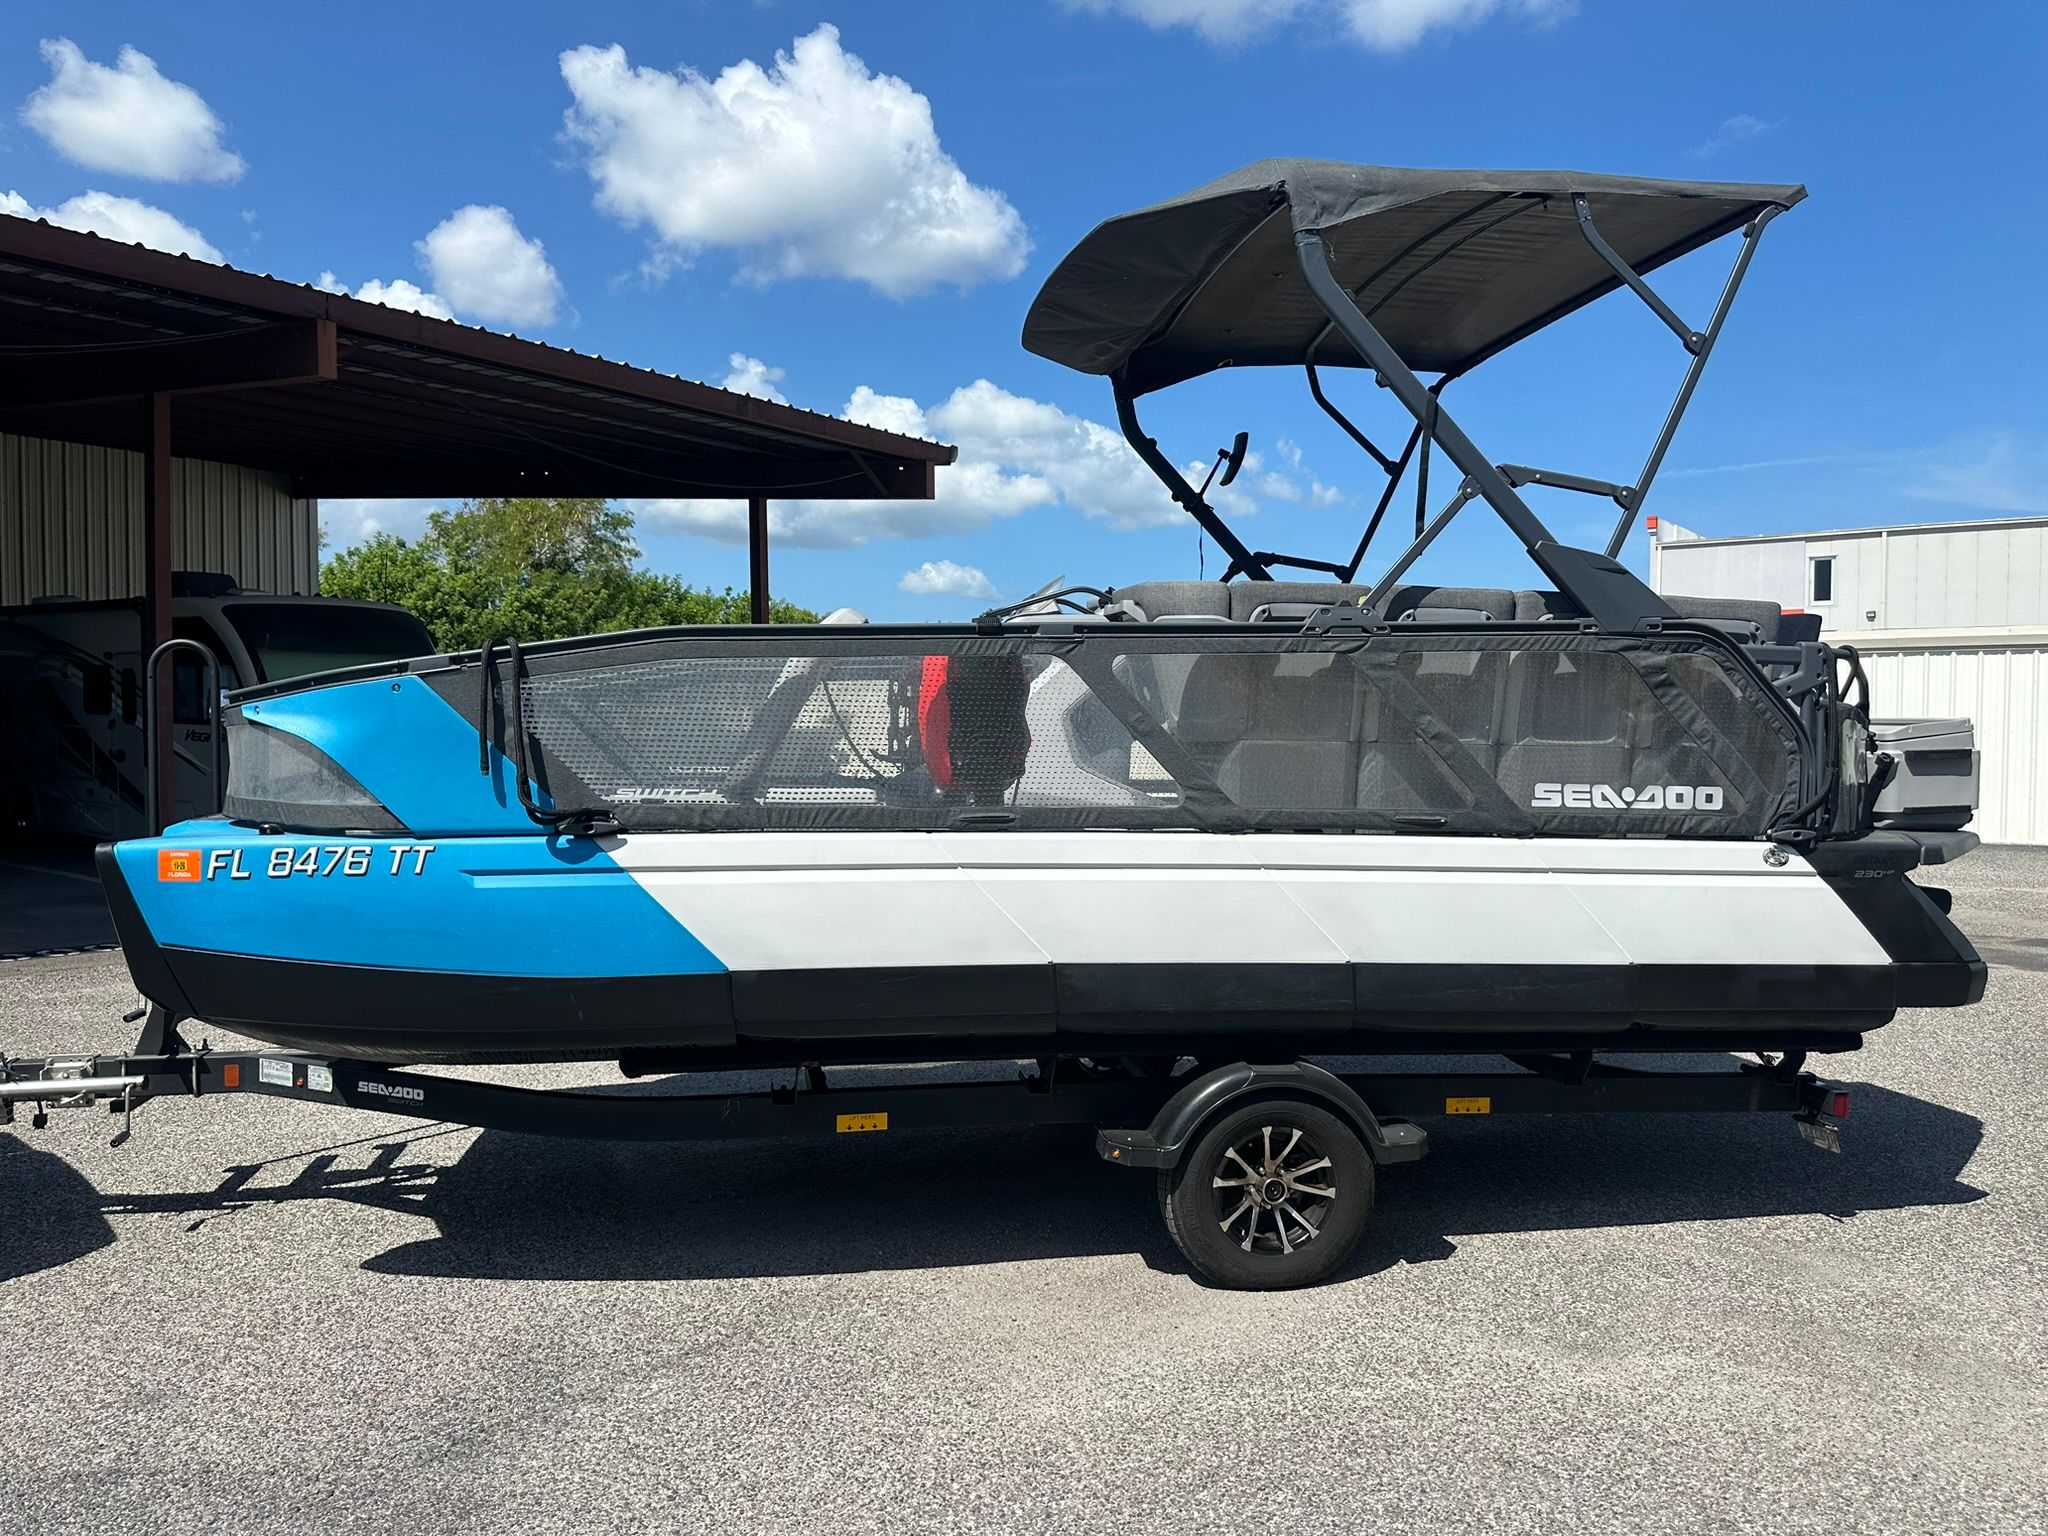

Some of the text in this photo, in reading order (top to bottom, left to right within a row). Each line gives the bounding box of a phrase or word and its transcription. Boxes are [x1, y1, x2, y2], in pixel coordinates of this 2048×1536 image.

[207, 845, 436, 879] FL 8476 TT
